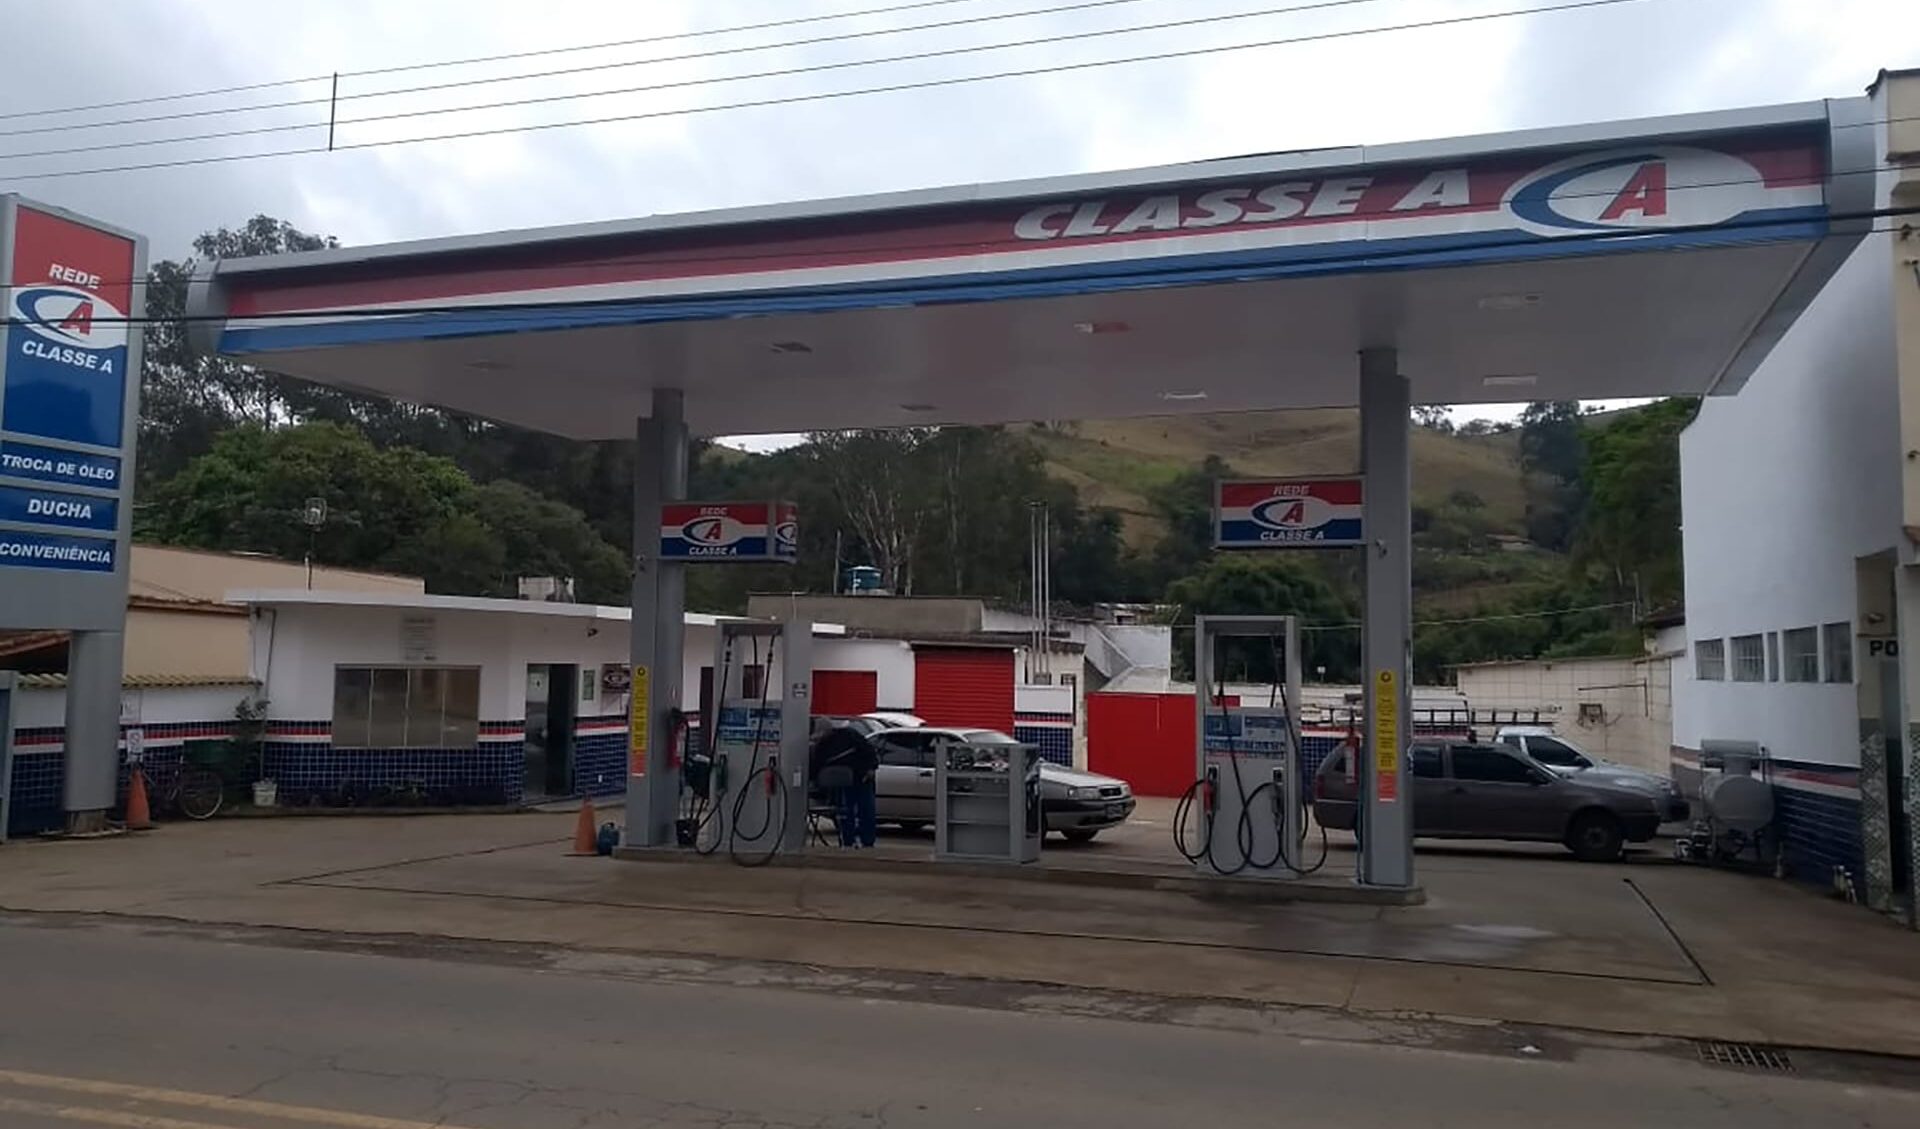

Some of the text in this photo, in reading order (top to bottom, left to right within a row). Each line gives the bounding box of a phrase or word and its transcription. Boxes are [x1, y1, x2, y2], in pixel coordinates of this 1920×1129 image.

[1597, 161, 1667, 220] A
[1012, 169, 1472, 241] CLASSE A
[48, 262, 102, 290] REDE
[58, 300, 94, 336] A
[22, 340, 113, 374] CLASSE A
[2, 453, 116, 480] TROCA DE ÓLEO
[1273, 484, 1310, 496] REDE
[27, 498, 92, 520] DUCHA
[1281, 502, 1305, 524] A
[1260, 530, 1325, 541] CLASSE A
[0, 542, 112, 564] CONVENIÊNCIA
